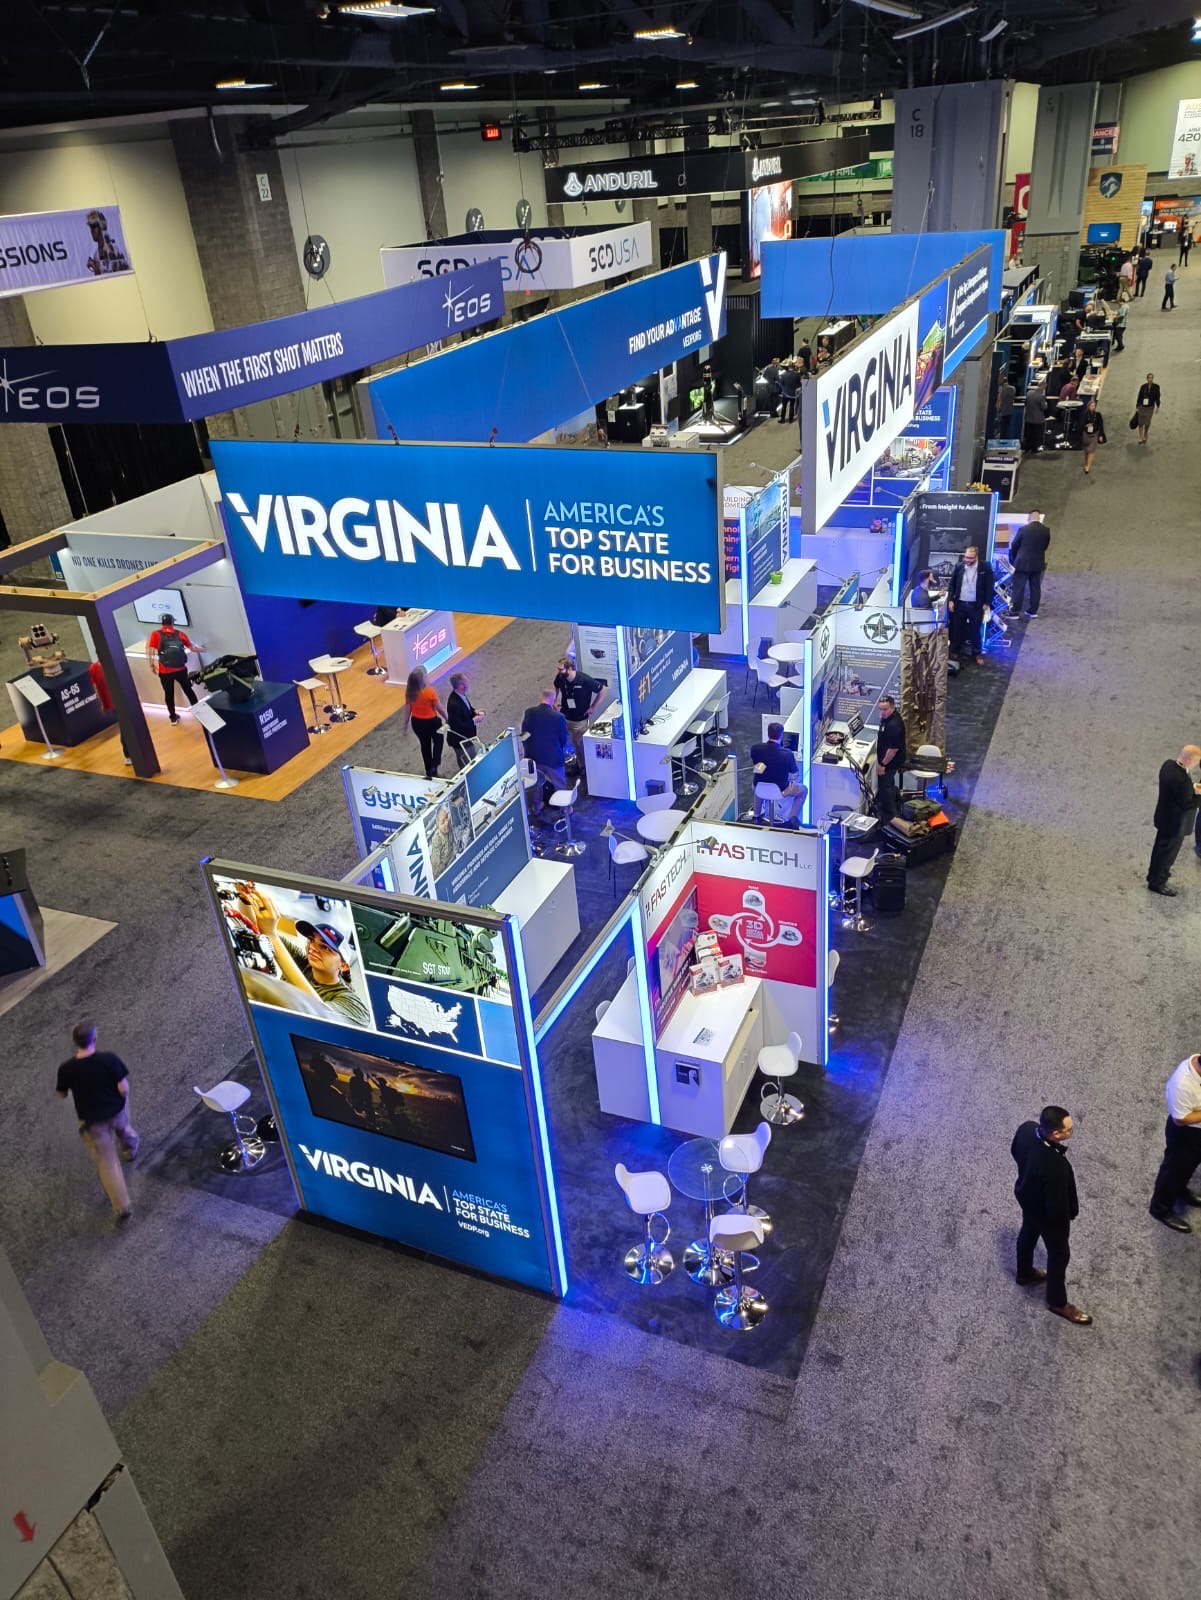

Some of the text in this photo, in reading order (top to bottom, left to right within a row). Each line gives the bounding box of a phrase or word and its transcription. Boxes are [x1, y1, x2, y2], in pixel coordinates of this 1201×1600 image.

[912, 109, 921, 121] C
[911, 125, 924, 138] 18
[584, 170, 658, 192] ANDURIL
[454, 293, 491, 323] EOS
[629, 306, 702, 355] FIND YOUR ADVANTAGE
[181, 332, 344, 398] WHEN THE FIRST SHOT MATTERS
[18, 386, 100, 410] EOS
[822, 328, 912, 482] VIRGINIA
[544, 500, 665, 527] AMERICA'S
[938, 503, 957, 511] Insight
[226, 492, 522, 571] VIRGINIA
[545, 526, 670, 555] TOP STATE
[72, 555, 82, 567] NO
[83, 556, 97, 568] ONE
[98, 558, 116, 569] KILLS
[117, 559, 144, 571] DRONES
[549, 553, 711, 584] FOR BUSINESS
[420, 629, 446, 655] EOS
[60, 682, 80, 701] AS-65
[639, 671, 650, 703] #1
[259, 708, 274, 726] R150
[362, 788, 429, 810] gyrus
[651, 848, 687, 912] FASTECH
[746, 920, 763, 930] 3D
[422, 962, 436, 974] SGT
[298, 1143, 443, 1211] VIRGINIA
[452, 1189, 508, 1213] AMERICA'S
[453, 1197, 511, 1223] TOP STATE
[455, 1207, 530, 1238] FOR BUSINESS
[458, 1220, 490, 1238] VEDP.org
